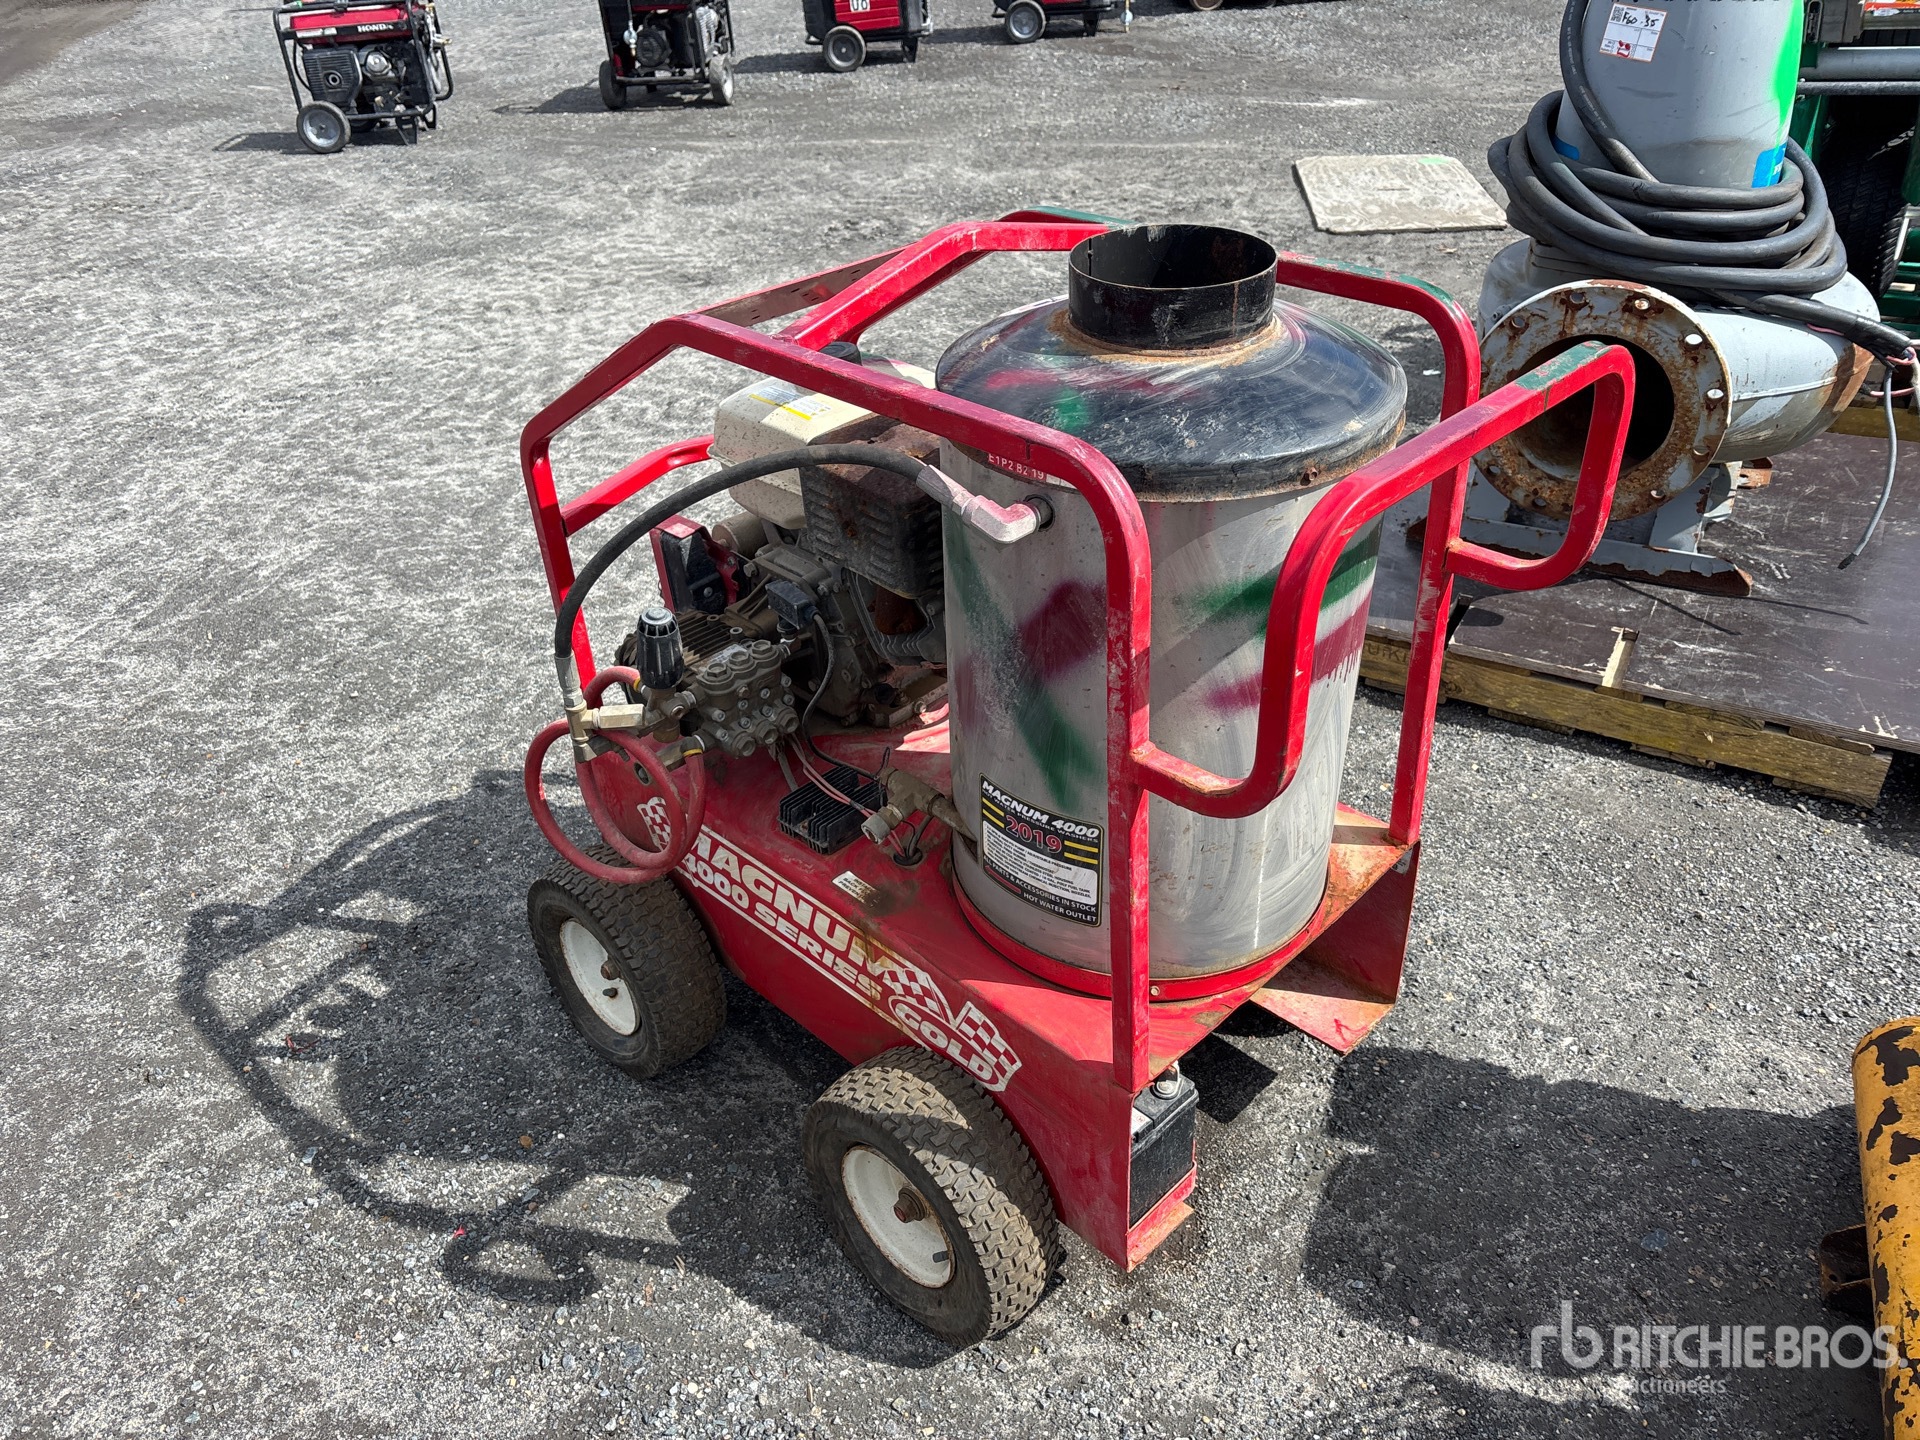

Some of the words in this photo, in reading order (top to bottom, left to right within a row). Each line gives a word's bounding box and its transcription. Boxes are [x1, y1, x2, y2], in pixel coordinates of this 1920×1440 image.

[357, 23, 394, 33] HONDA
[982, 780, 1049, 824] MAGNUM
[1052, 820, 1099, 838] 4000
[1006, 815, 1062, 854] 2019
[1057, 828, 1098, 842] WASHERS
[992, 861, 1008, 878] PARTS
[1010, 873, 1014, 882] &
[1016, 876, 1059, 904] ACCESSORIES
[1071, 900, 1096, 912] STOCK
[1024, 890, 1037, 903] HOT
[1039, 898, 1064, 914] WATER
[1066, 909, 1096, 921] OUTLET
[682, 853, 749, 909] 4000
[754, 902, 882, 1000] SERIES
[895, 1003, 993, 1080] GOLD
